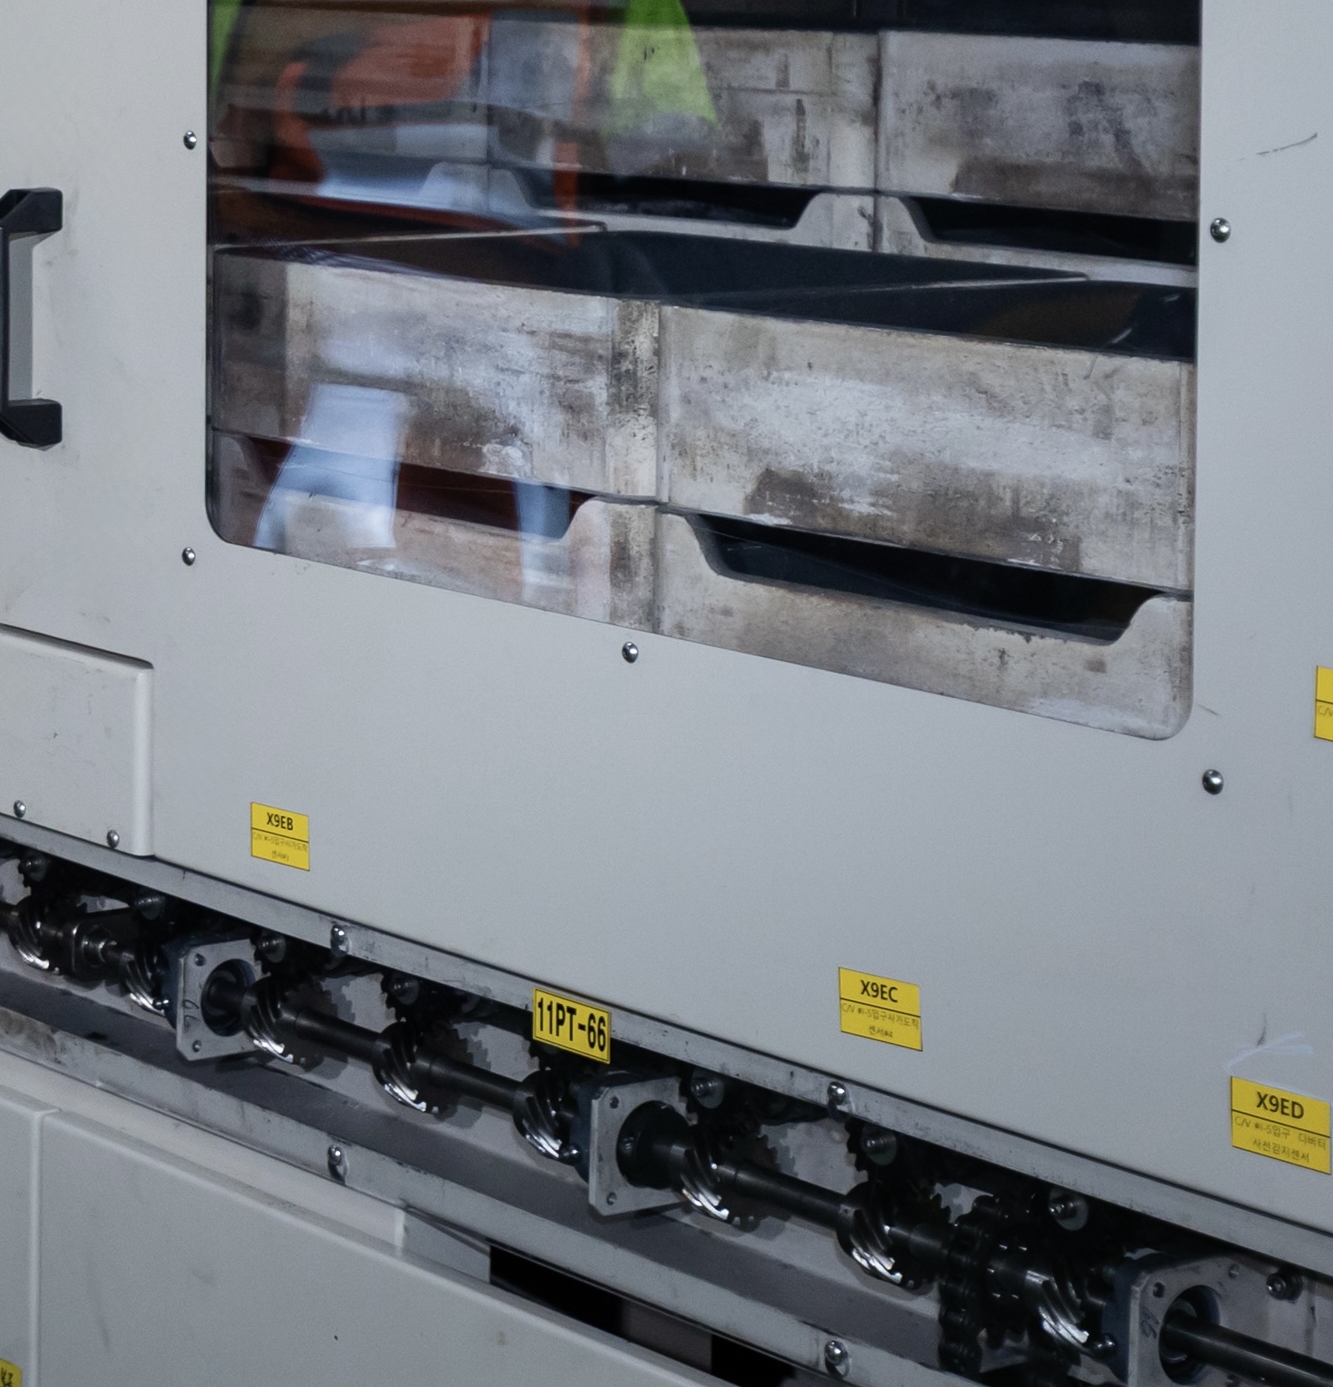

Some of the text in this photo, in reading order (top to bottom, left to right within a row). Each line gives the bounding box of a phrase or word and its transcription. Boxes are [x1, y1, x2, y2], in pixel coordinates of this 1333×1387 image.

[266, 811, 294, 831] X9EB
[860, 979, 899, 1003] X9EC
[537, 997, 607, 1053] 11PT-66
[1256, 1091, 1305, 1120] X9ED
